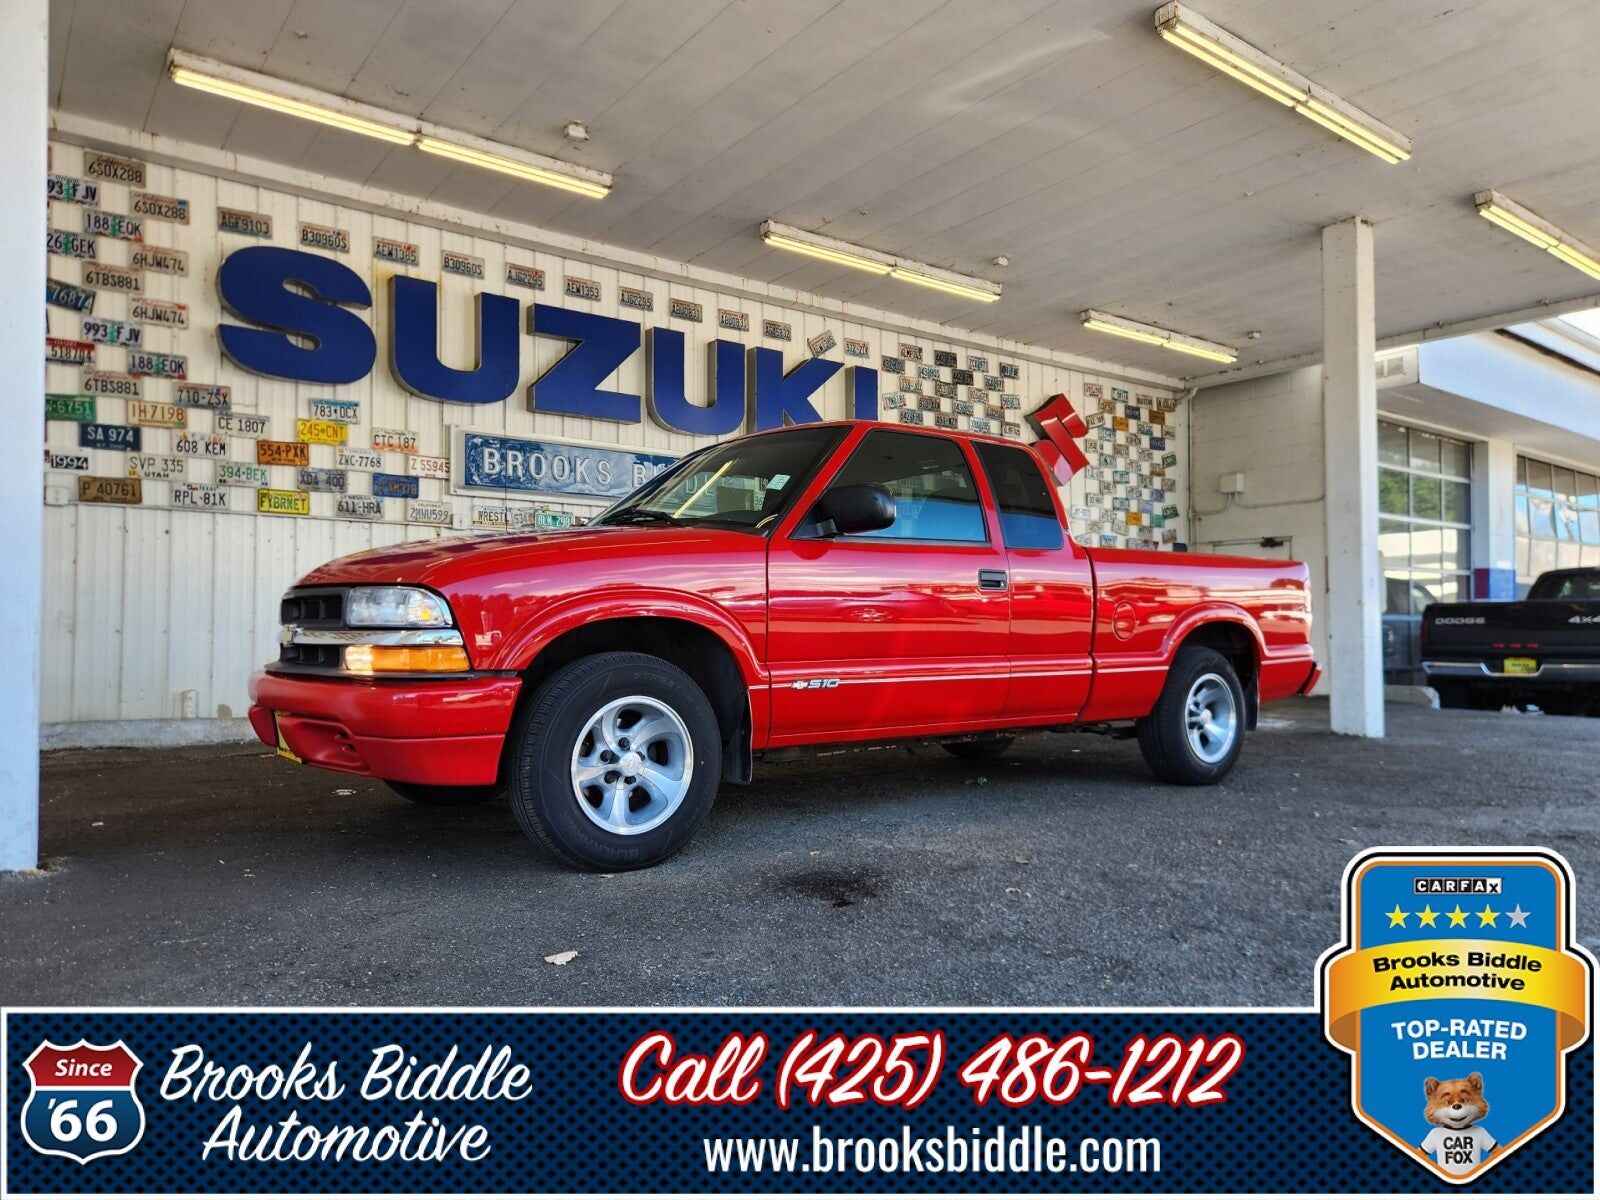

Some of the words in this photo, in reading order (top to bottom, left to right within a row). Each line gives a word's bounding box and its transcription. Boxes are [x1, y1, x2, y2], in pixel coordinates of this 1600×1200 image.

[133, 252, 184, 272] 6HJW474
[86, 271, 140, 290] 6TBS881
[133, 305, 184, 325] 6HJW474
[84, 321, 108, 338] 993
[217, 246, 878, 434] SUZUKI
[84, 378, 139, 395] 6TBS881
[218, 417, 233, 431] CE
[238, 419, 265, 434] 1807
[87, 427, 104, 440] SA
[109, 428, 134, 443] 974
[374, 434, 393, 447] CTC
[176, 439, 198, 453] 608
[52, 456, 88, 469] 1994
[130, 457, 155, 471] SVP
[162, 458, 184, 473] 335
[481, 447, 613, 486] BROOKS
[83, 482, 90, 495] P
[97, 483, 136, 497] 40761
